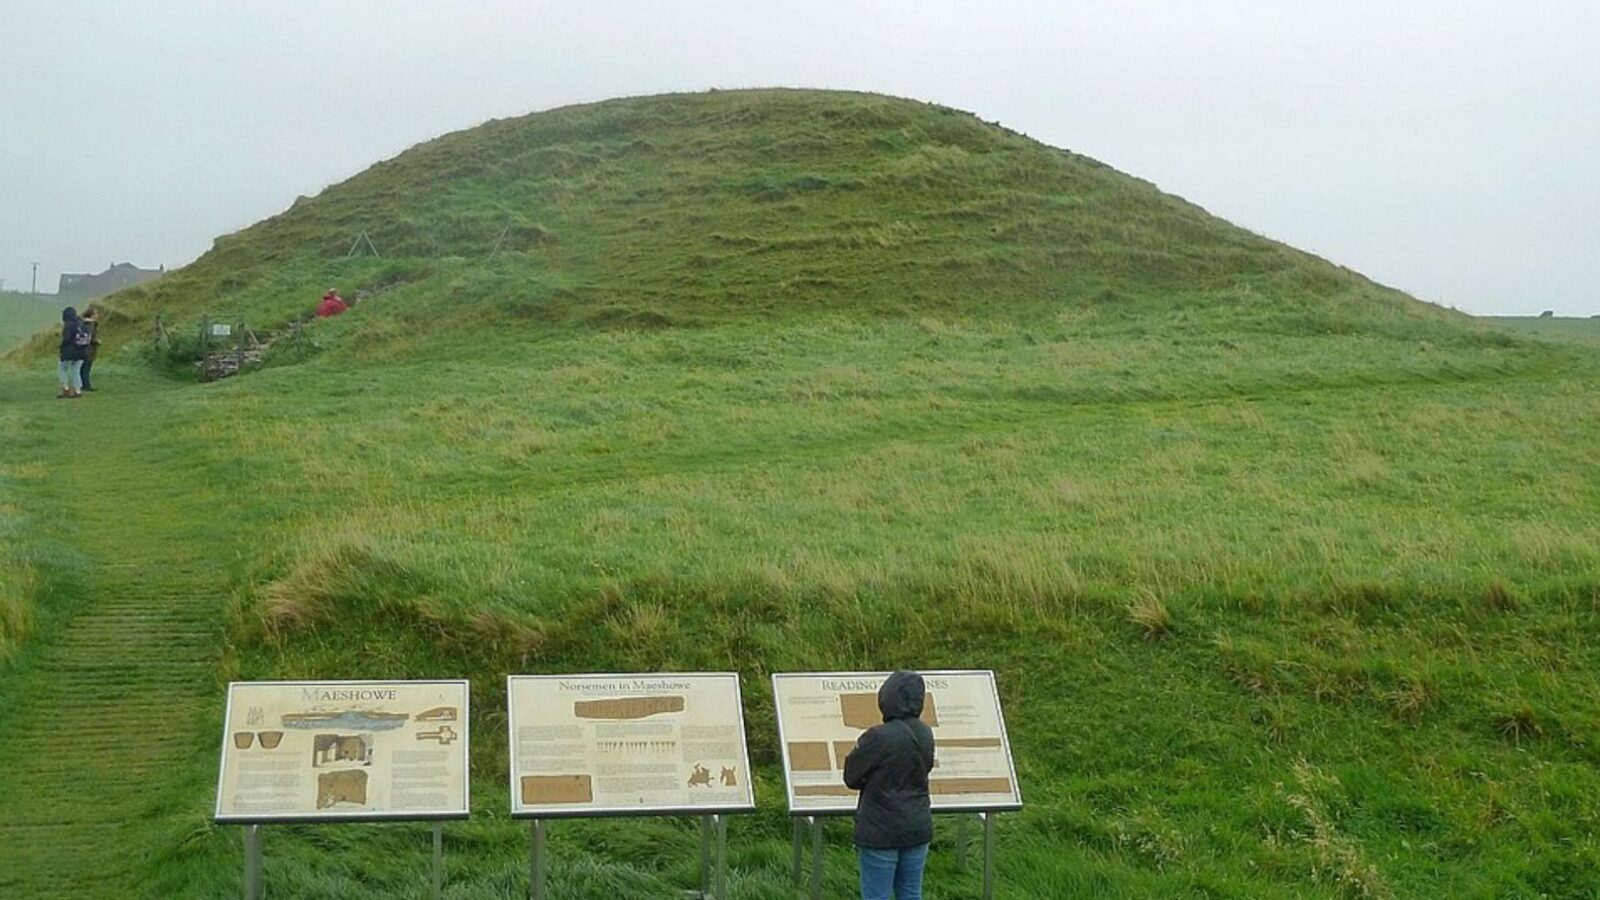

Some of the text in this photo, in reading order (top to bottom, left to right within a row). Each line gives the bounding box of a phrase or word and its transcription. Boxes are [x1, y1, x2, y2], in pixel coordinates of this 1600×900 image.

[558, 679, 692, 691] Norsemen in Maeshowe
[821, 680, 878, 691] READING
[302, 687, 397, 701] MAESHOWE
